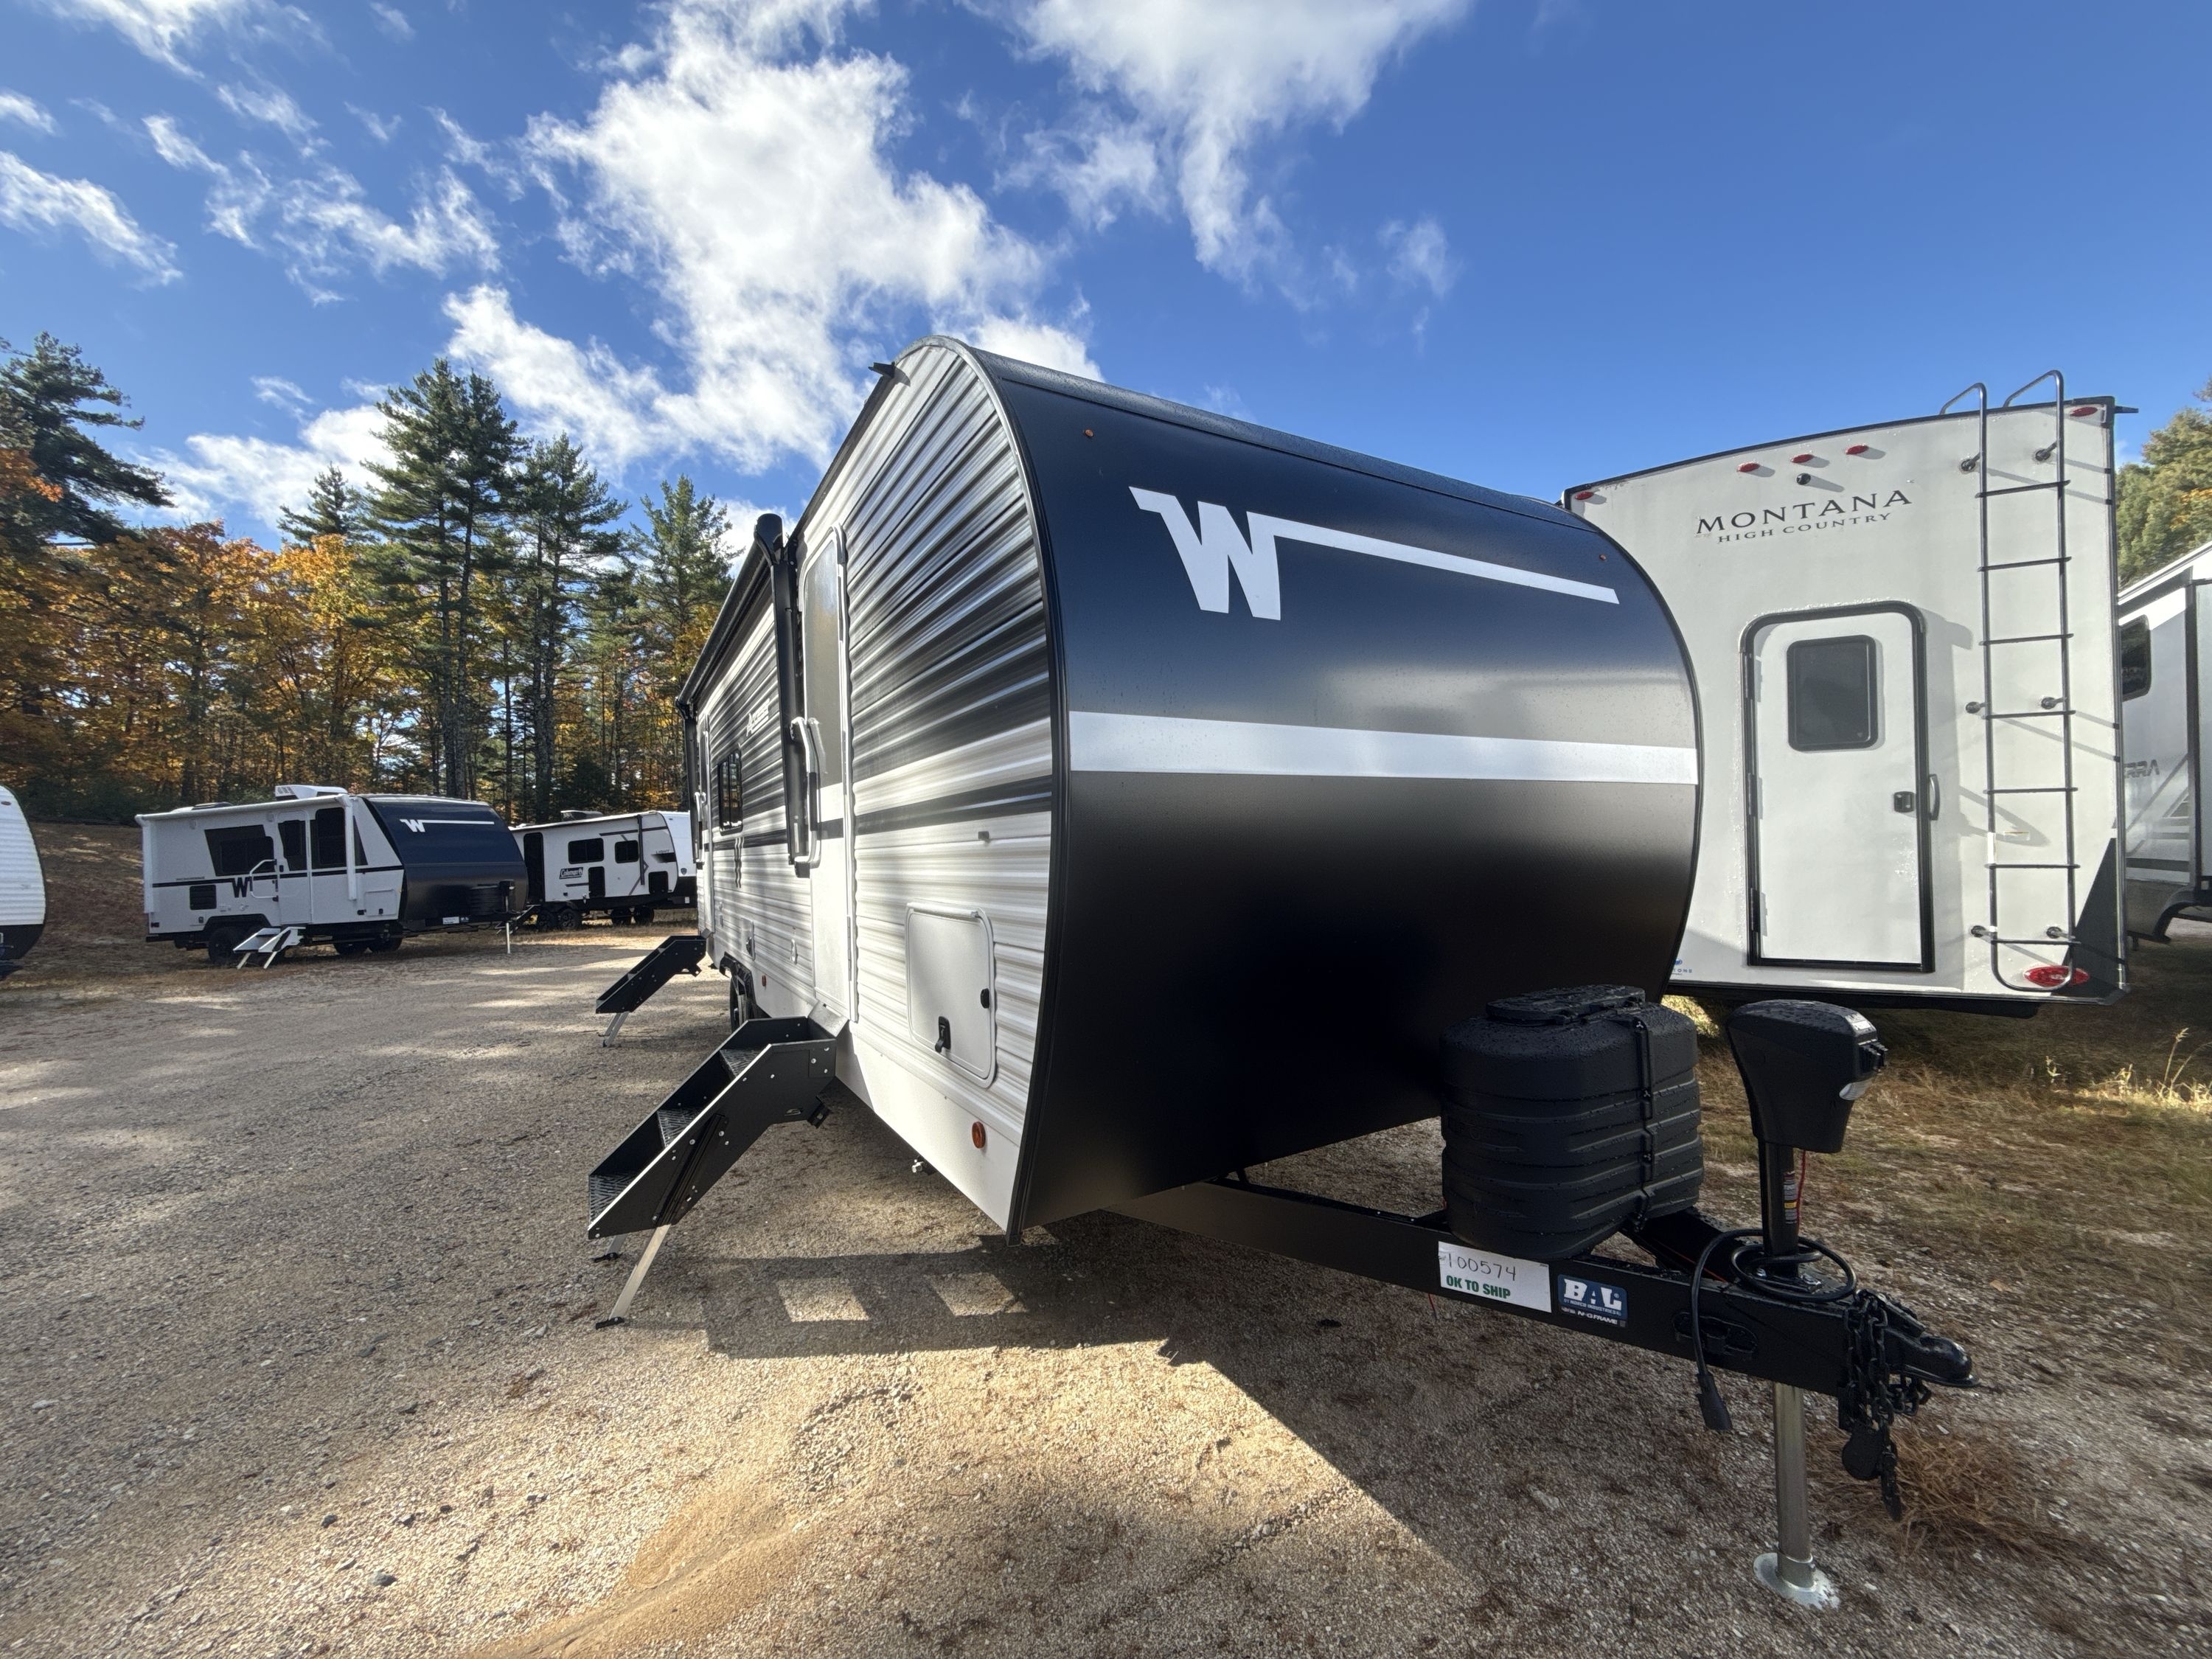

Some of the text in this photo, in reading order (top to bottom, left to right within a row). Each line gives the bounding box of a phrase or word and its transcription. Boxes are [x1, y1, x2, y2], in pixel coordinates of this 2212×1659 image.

[1696, 490, 1912, 534] MONTANA
[1718, 512, 1891, 543] HIGH COUNTRY
[1448, 1253, 1517, 1281] 100574
[1446, 1275, 1511, 1299] OK TO SHIP
[1564, 1279, 1622, 1311] BAL
